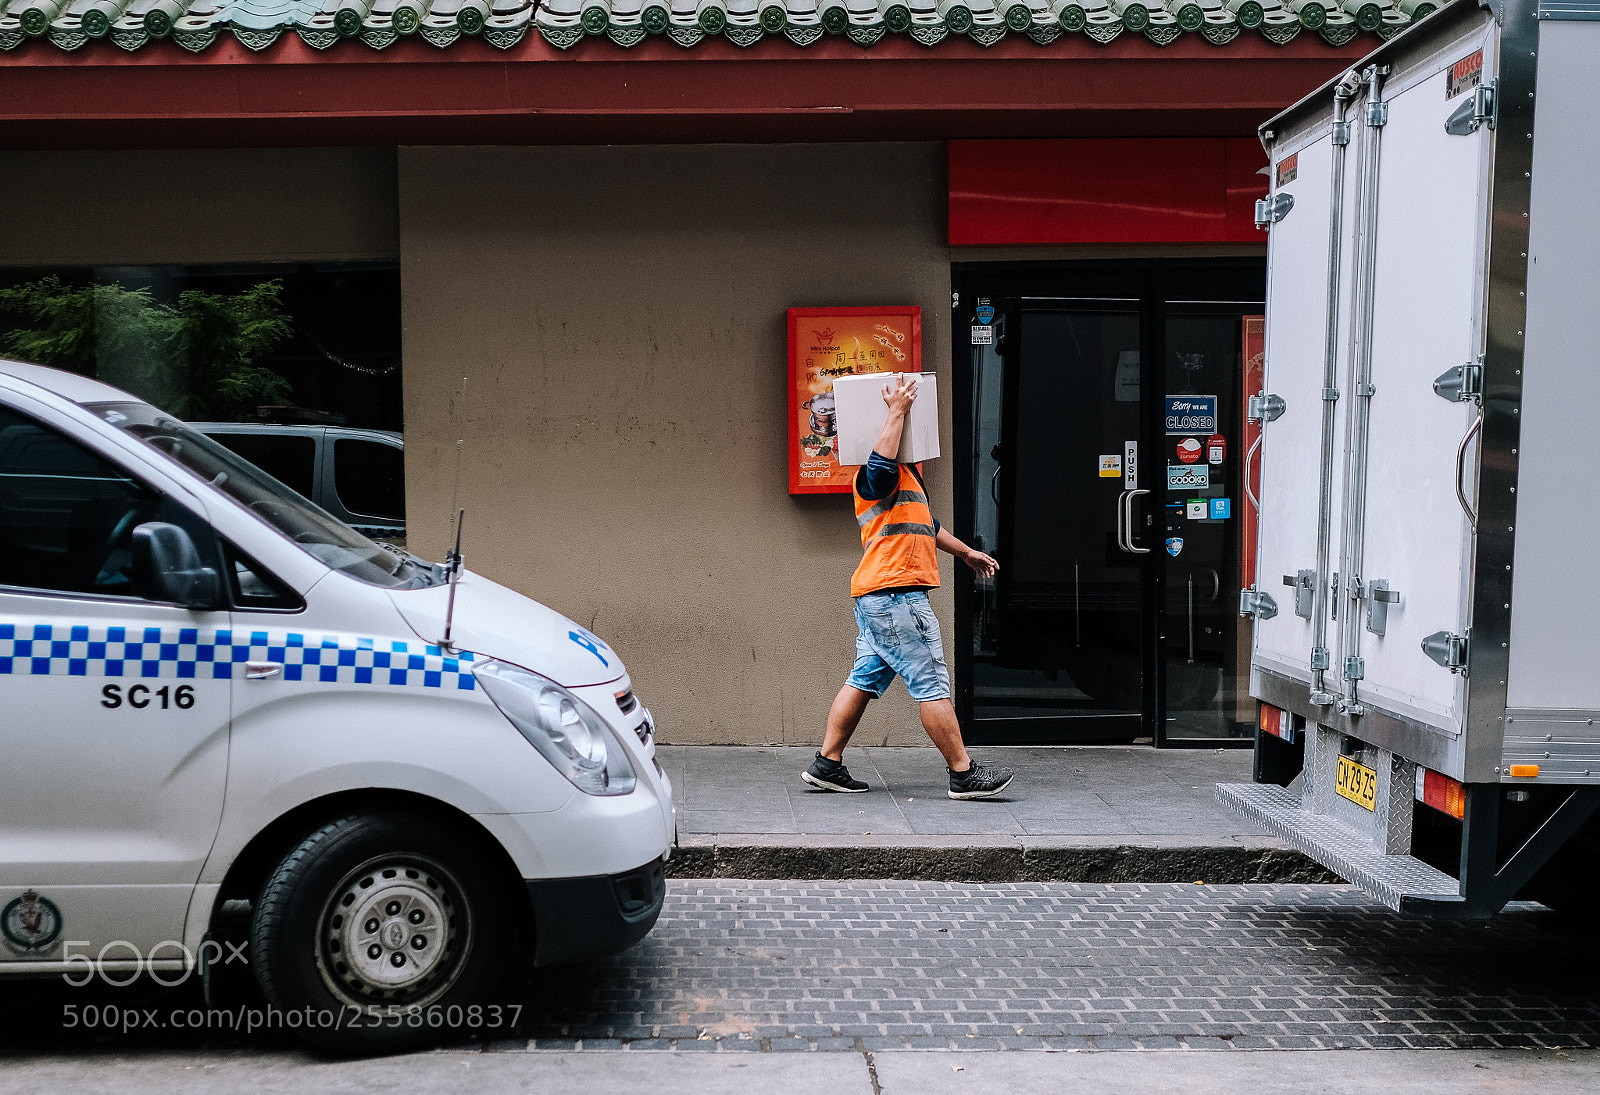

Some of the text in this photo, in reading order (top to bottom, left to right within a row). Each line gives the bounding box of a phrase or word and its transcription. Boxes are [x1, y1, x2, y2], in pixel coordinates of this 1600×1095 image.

[1171, 401, 1191, 413] Sorry
[1166, 415, 1213, 428] CLOSED
[1127, 448, 1135, 482] PUSH
[1169, 475, 1207, 485] GODOKO
[101, 684, 195, 709] SC16
